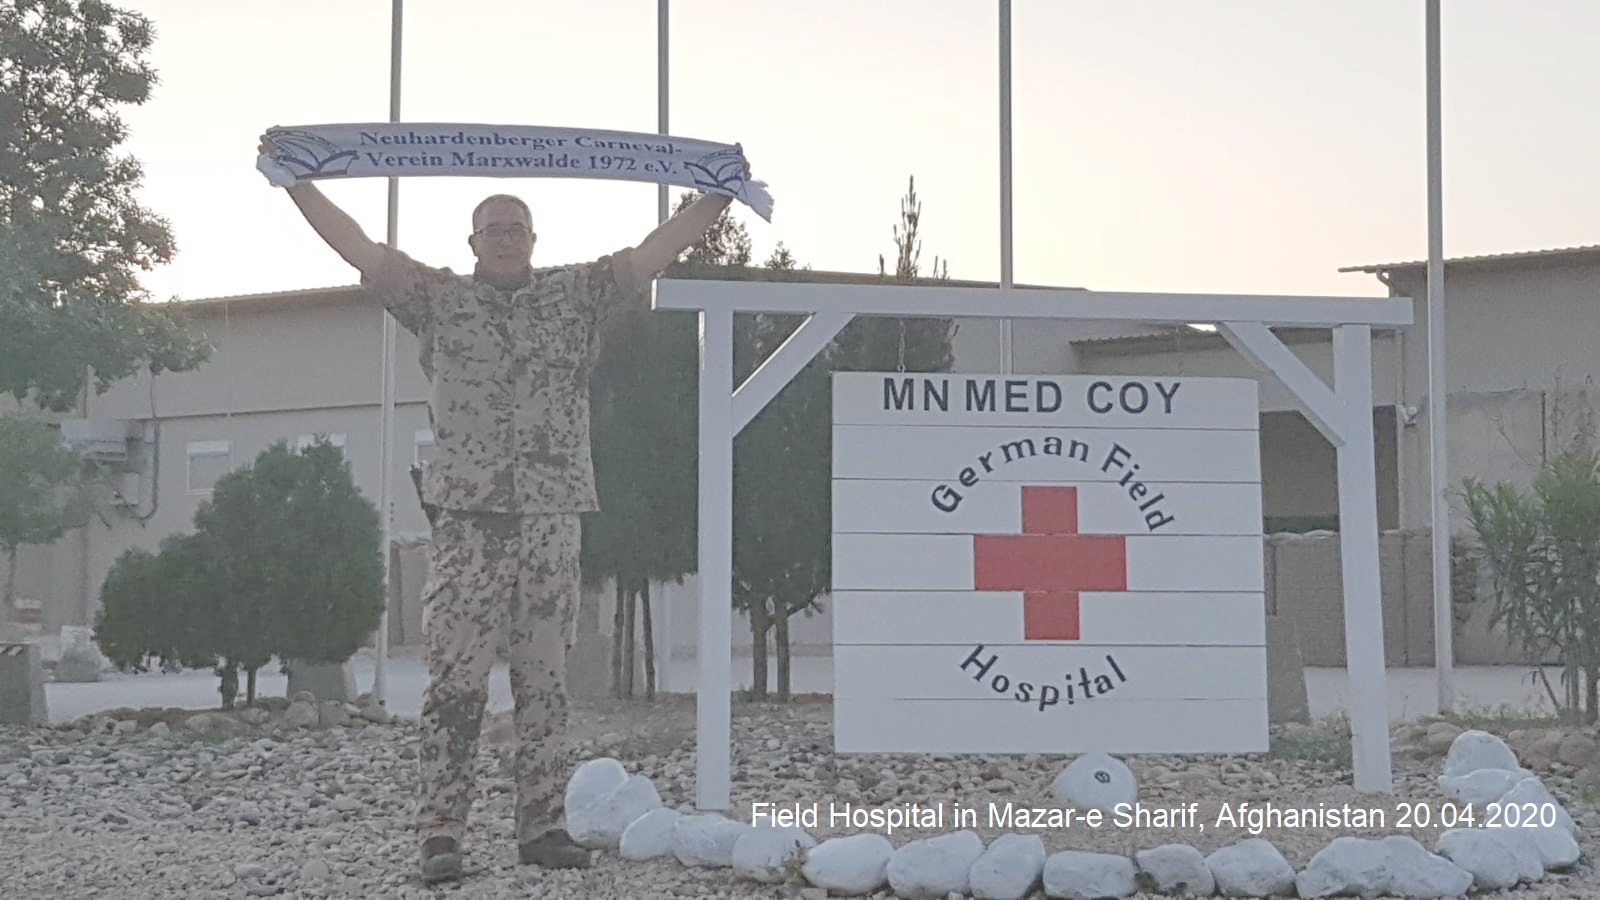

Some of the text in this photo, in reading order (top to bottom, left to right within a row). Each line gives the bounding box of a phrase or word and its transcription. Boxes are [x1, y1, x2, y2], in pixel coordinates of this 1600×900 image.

[360, 131, 683, 155] Neuhardenberger Carneval-
[366, 150, 678, 175] Verein Marxwalde 1972 e.V.
[883, 378, 1182, 415] MN MED COY
[931, 436, 1175, 532] German Field
[959, 643, 1127, 712] Hospital
